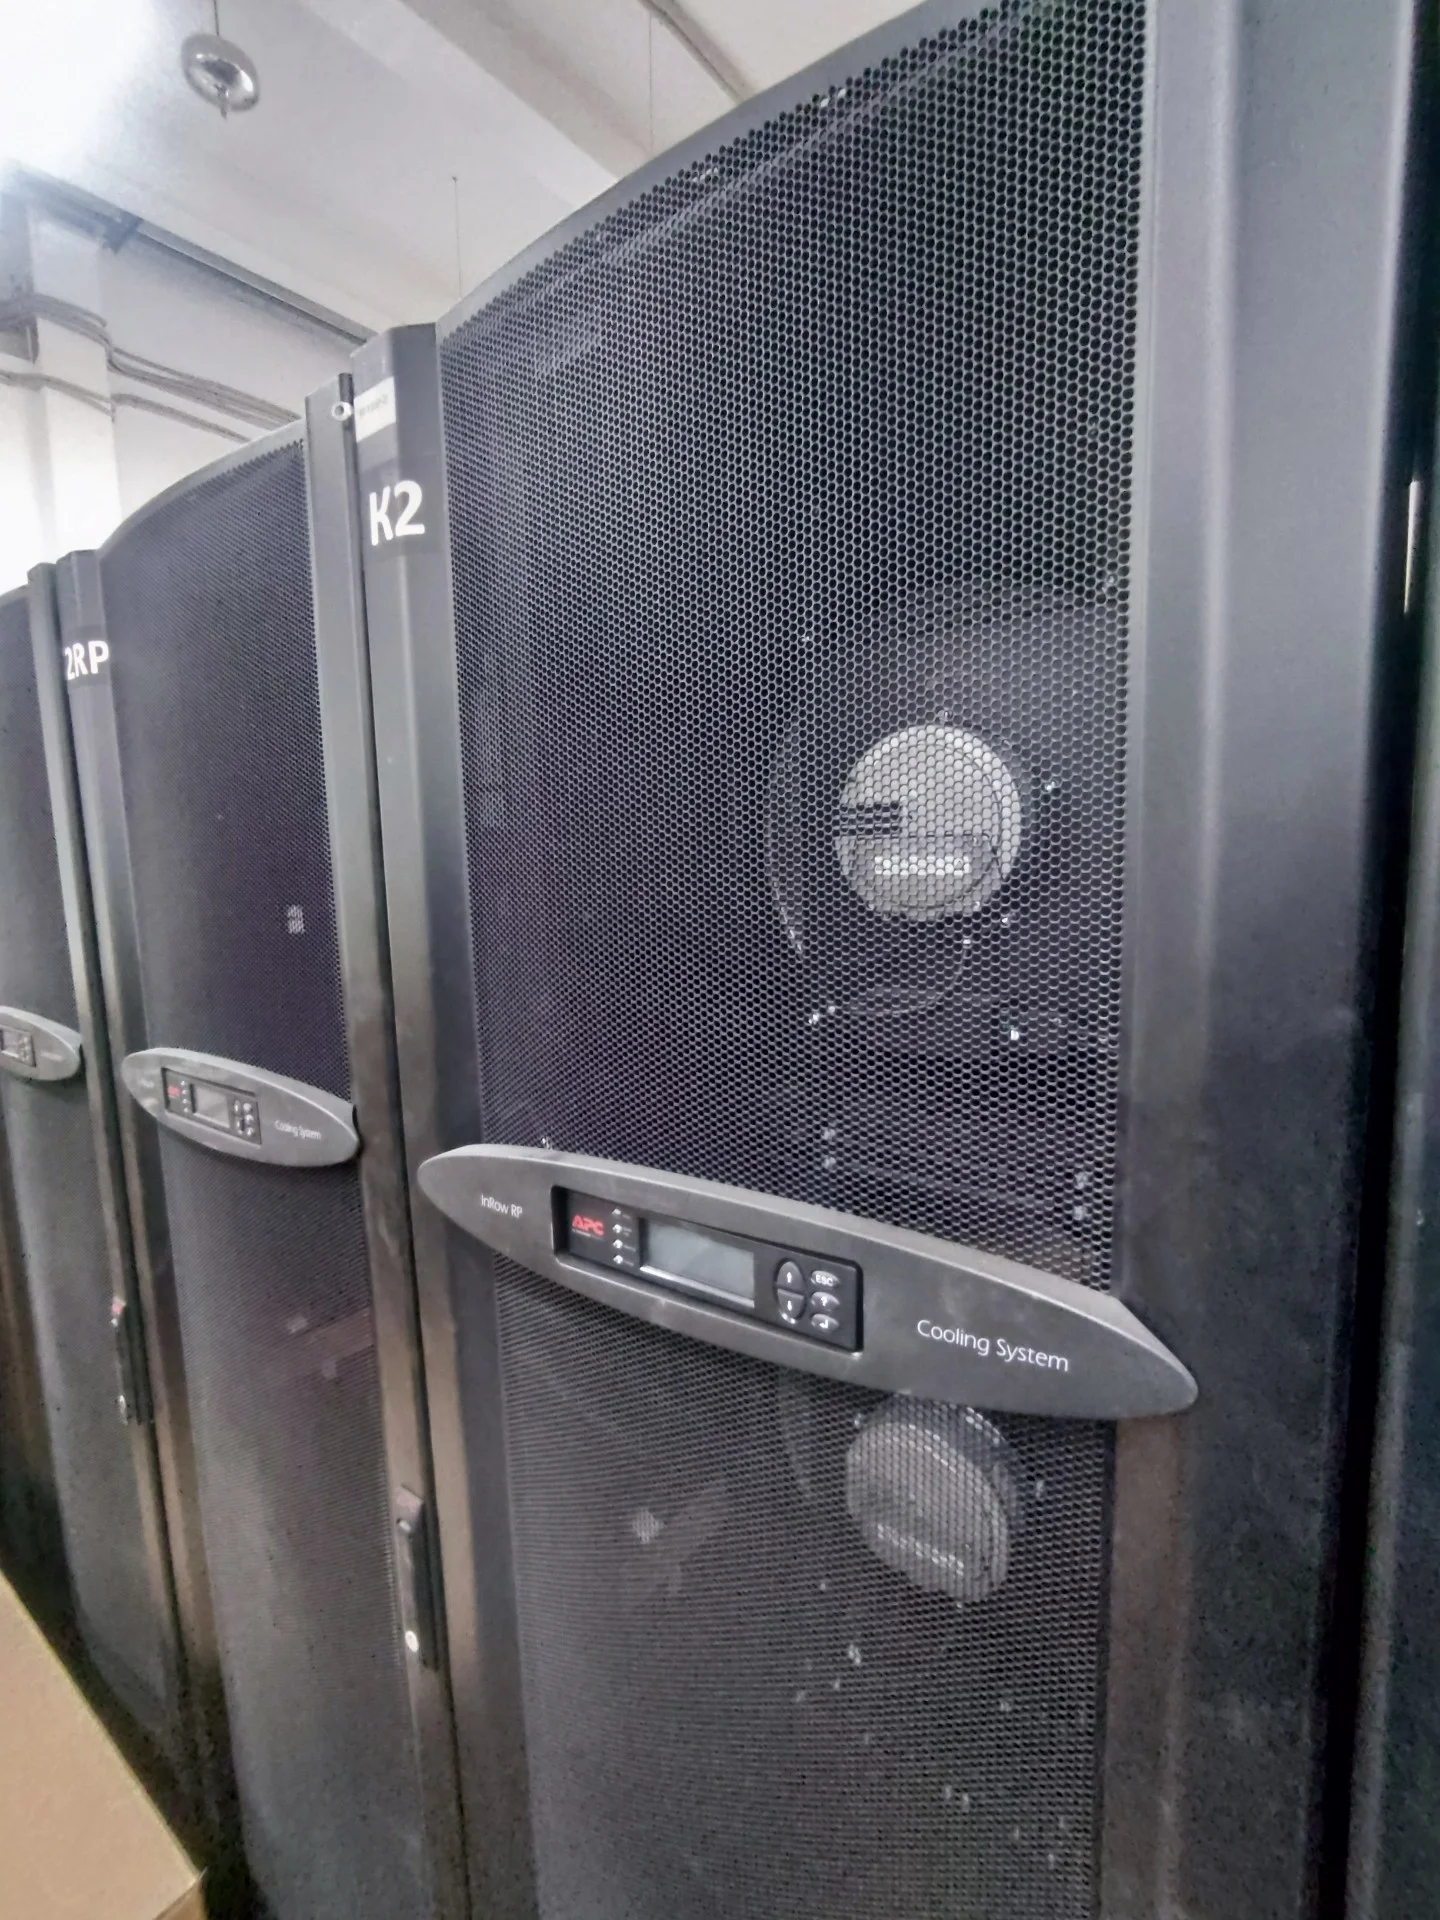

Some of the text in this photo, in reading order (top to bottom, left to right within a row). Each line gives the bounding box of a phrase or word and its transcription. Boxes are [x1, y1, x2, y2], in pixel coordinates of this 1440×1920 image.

[369, 480, 426, 546] K2
[64, 640, 110, 681] 2RP
[480, 1193, 523, 1219] InRow RP
[571, 1214, 605, 1237] APC
[815, 1273, 834, 1287] ESC
[916, 1319, 1070, 1373] Cooling System
